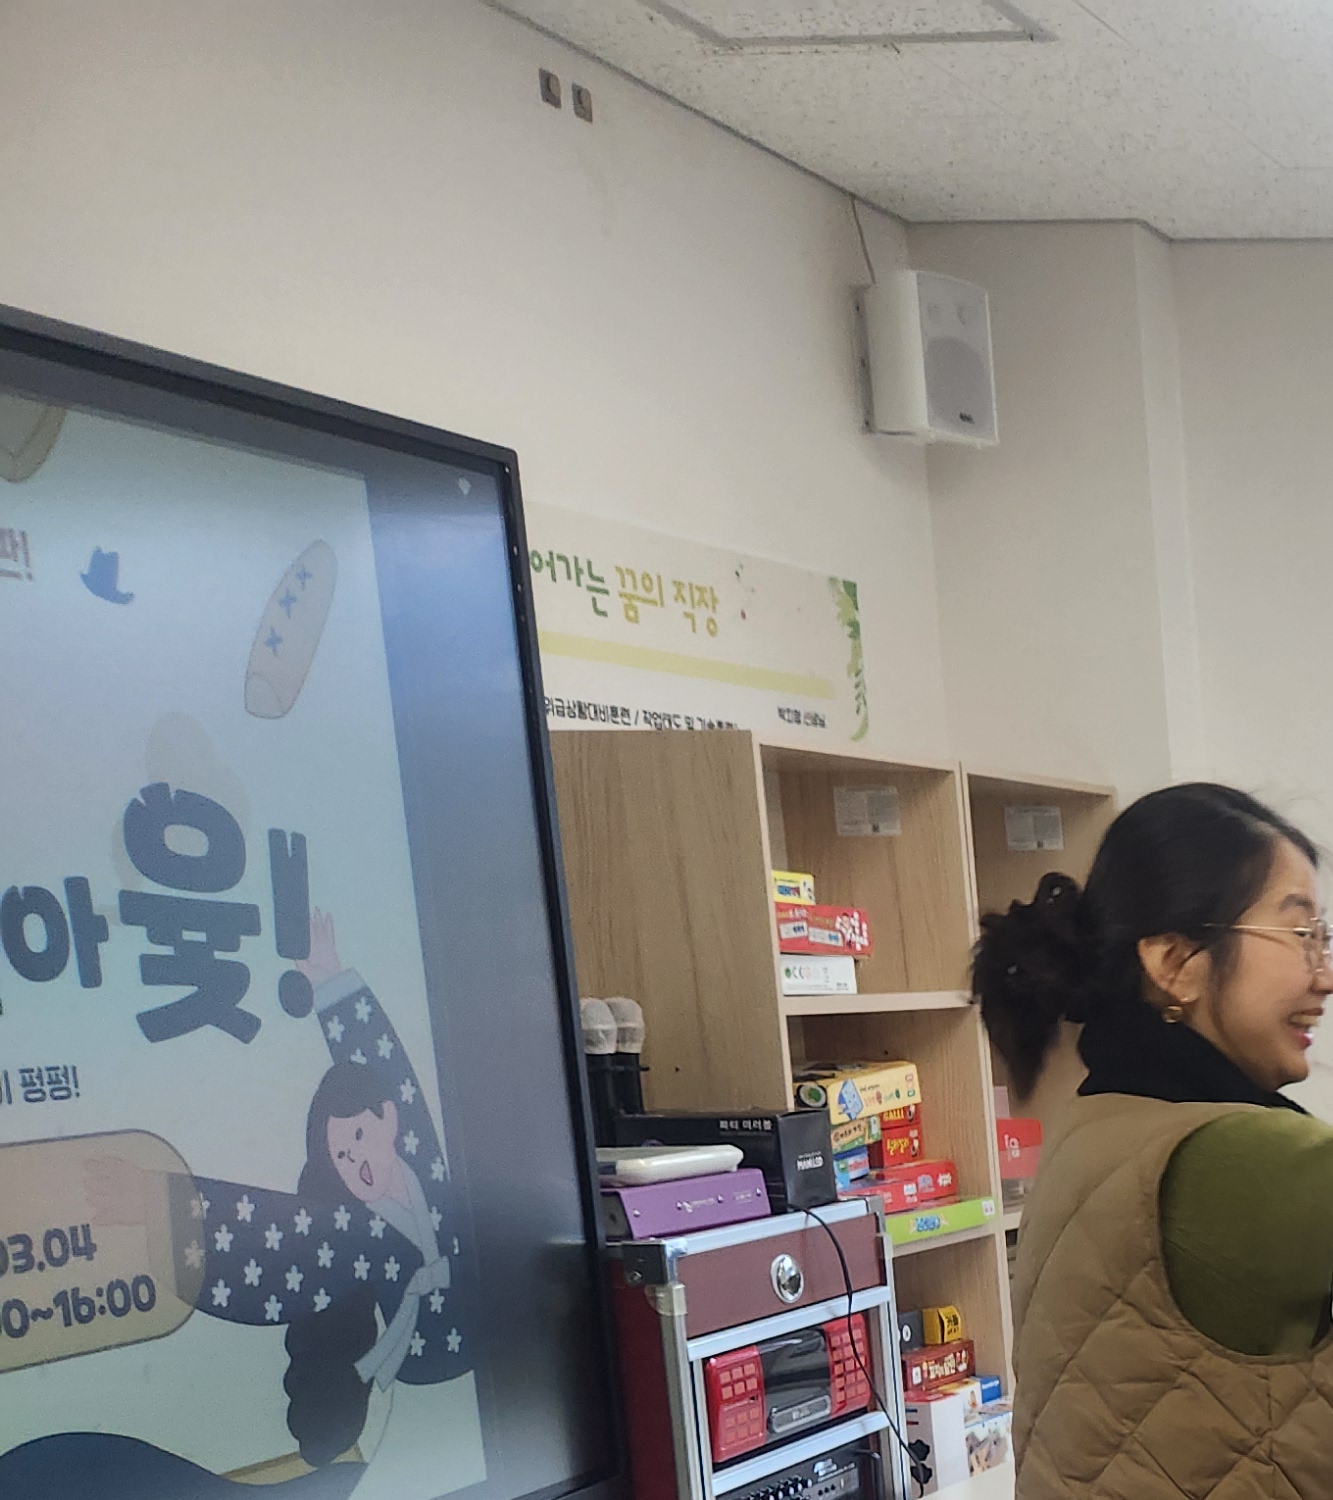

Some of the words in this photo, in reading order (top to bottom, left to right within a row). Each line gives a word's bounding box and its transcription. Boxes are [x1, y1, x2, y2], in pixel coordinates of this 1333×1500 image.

[614, 566, 664, 624] 꿈의
[672, 579, 719, 638] 직장
[18, 1064, 81, 1103] 펑펑!
